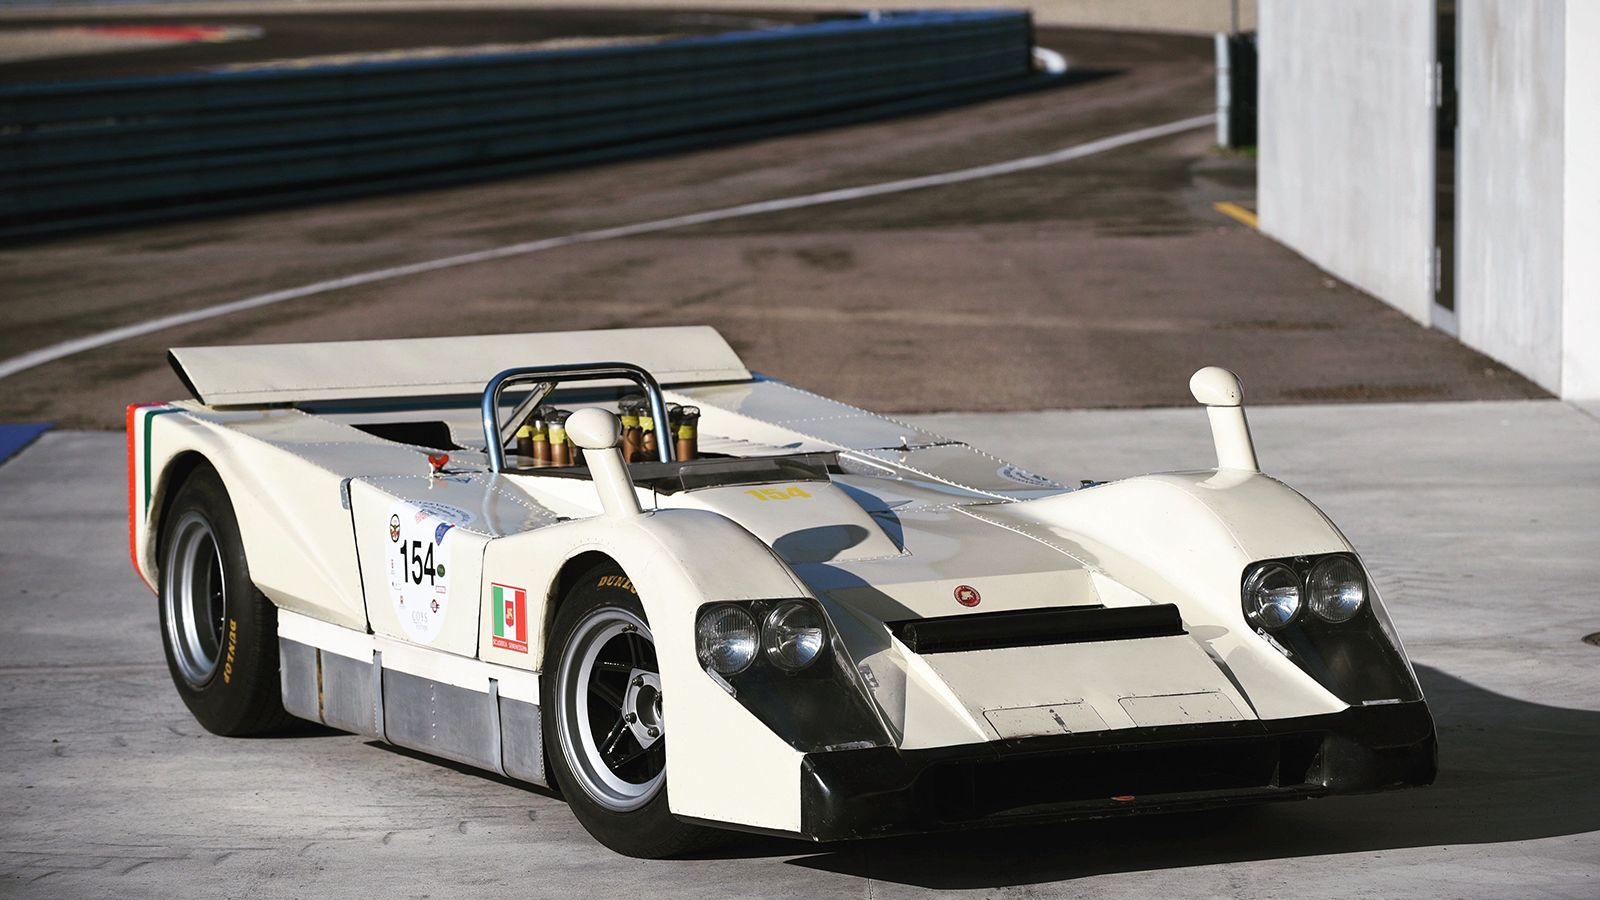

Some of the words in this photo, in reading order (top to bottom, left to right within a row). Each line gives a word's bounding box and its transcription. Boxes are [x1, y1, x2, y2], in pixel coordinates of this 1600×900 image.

[744, 487, 812, 501] 154
[400, 540, 436, 586] 154
[411, 611, 428, 622] COYS
[224, 619, 237, 684] DUNLOP
